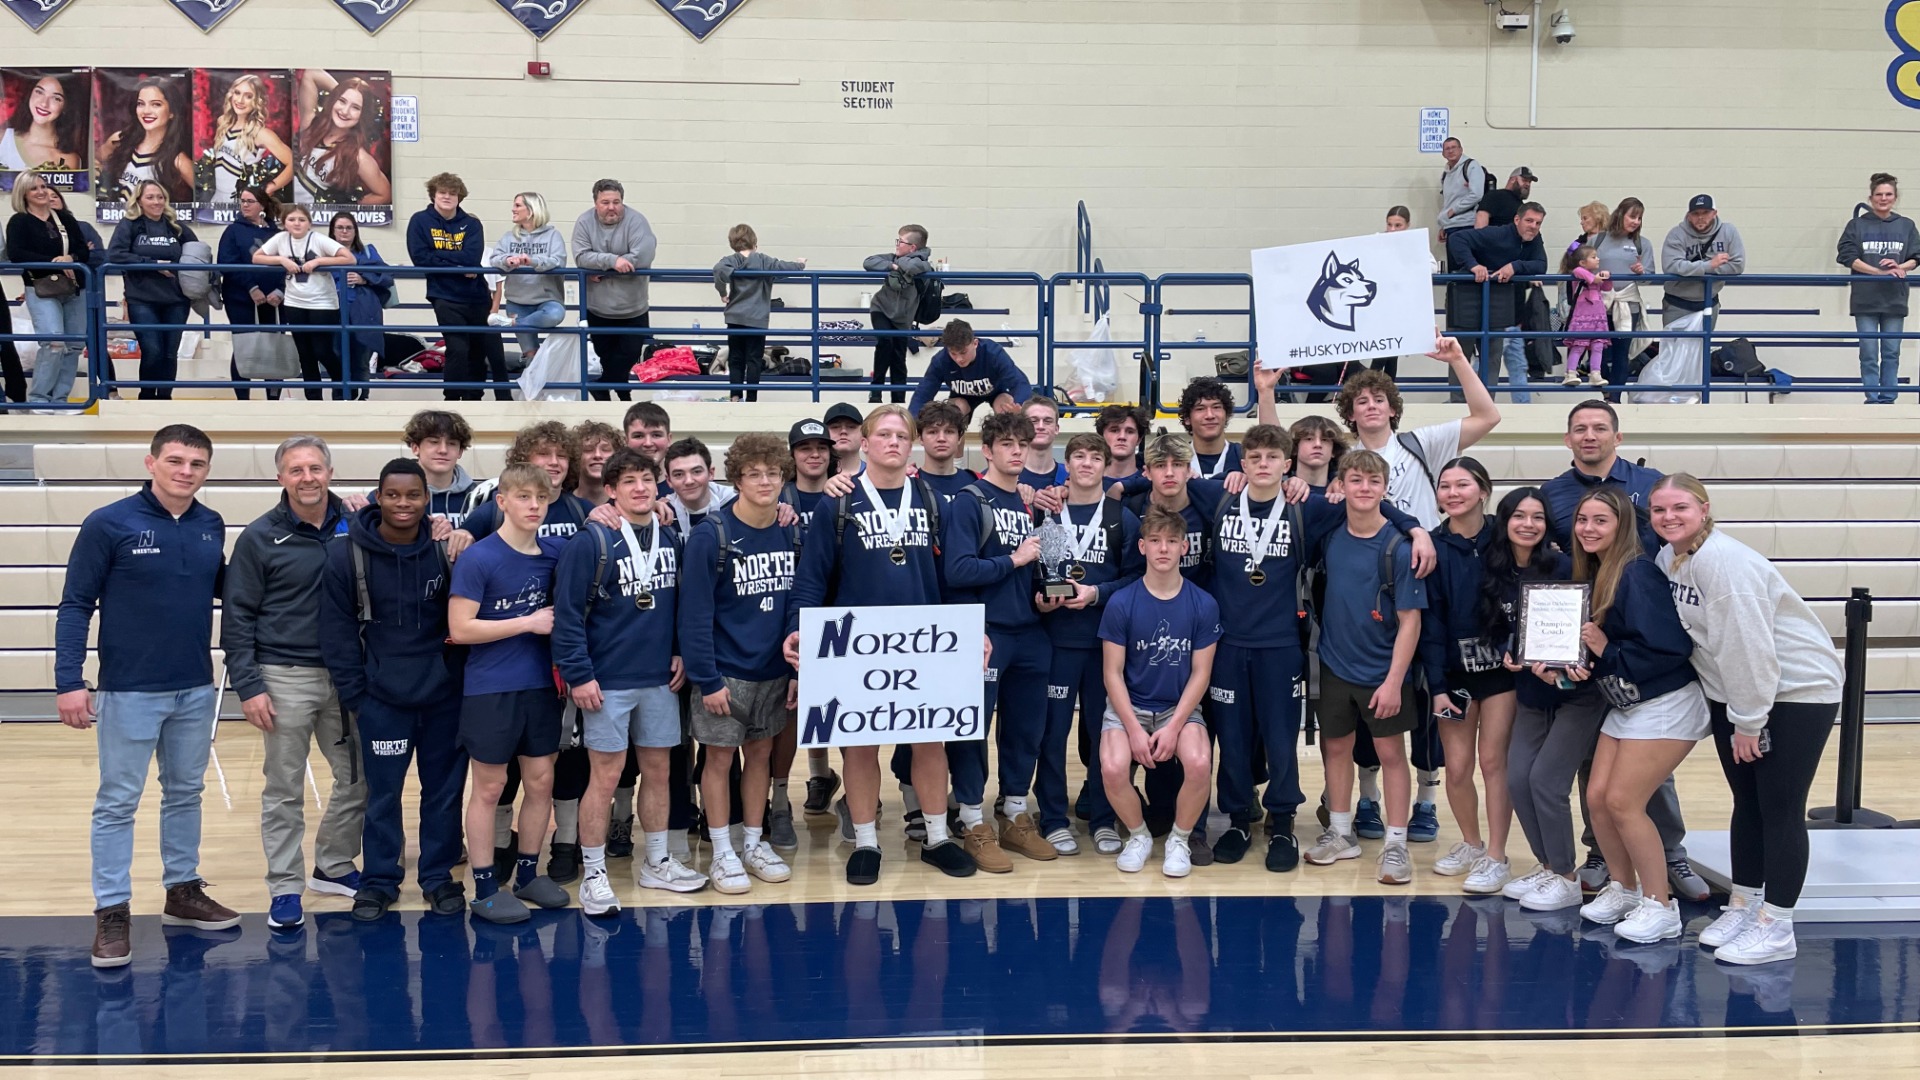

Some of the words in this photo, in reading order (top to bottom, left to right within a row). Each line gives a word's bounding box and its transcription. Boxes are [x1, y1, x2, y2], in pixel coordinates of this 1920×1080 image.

[841, 81, 895, 93] STUDENT
[395, 99, 410, 107] HOME
[843, 97, 893, 109] SECTION
[53, 173, 74, 184] COLE
[350, 211, 386, 223] ROVES
[1862, 241, 1904, 251] WRESTLING
[1289, 337, 1403, 358] #HUSKYDYNASTY
[951, 378, 993, 395] NORTH
[1220, 537, 1289, 557] WRESING
[616, 547, 676, 584] NTH
[732, 551, 795, 583] NORTH
[760, 596, 774, 612] 40
[1534, 620, 1572, 628] Champion
[1209, 686, 1235, 699] NORTH
[371, 738, 409, 750] NORTH
